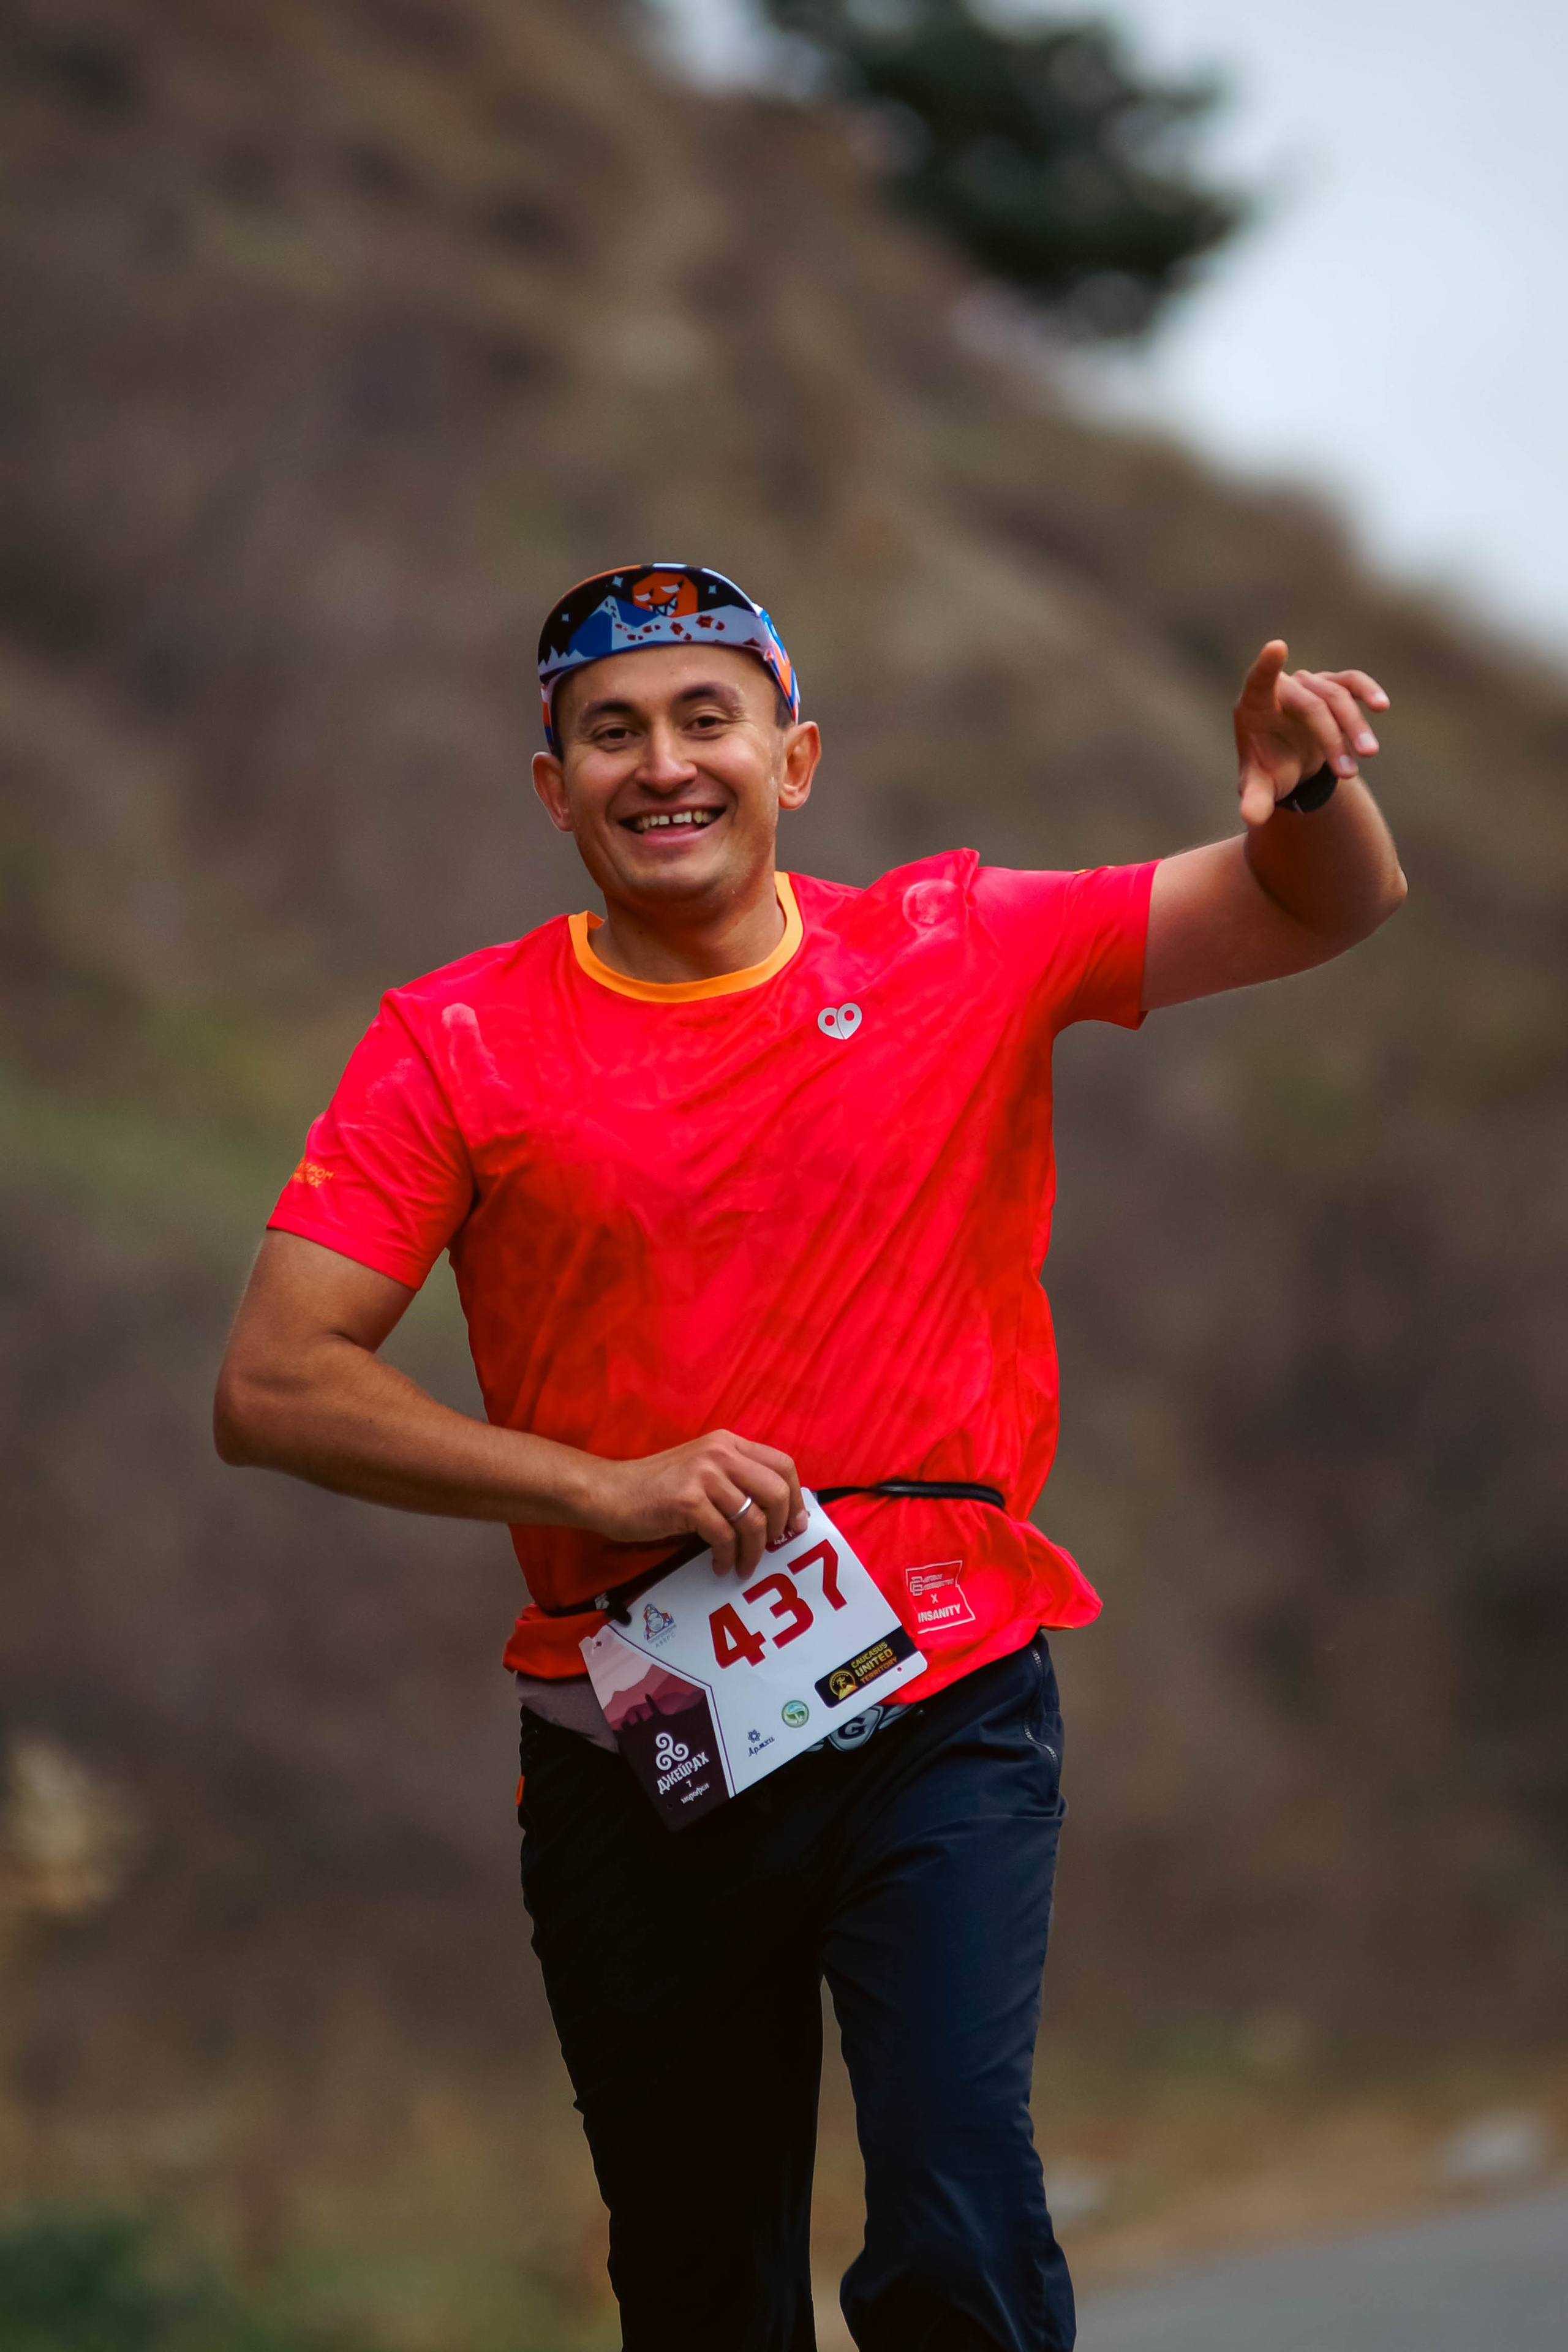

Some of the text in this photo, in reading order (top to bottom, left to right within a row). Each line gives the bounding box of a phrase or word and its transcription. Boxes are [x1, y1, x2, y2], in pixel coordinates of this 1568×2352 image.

[709, 1538, 848, 1669] 437
[918, 1604, 960, 1623] INSANITY
[851, 1642, 888, 1668] CAUCASUS
[854, 1648, 893, 1677] UNITED
[860, 1656, 897, 1684] TERRITORY
[838, 1717, 867, 1740] G
[657, 1752, 709, 1795] ДЖЕЙРАХ
[680, 1783, 710, 1804] марафон
